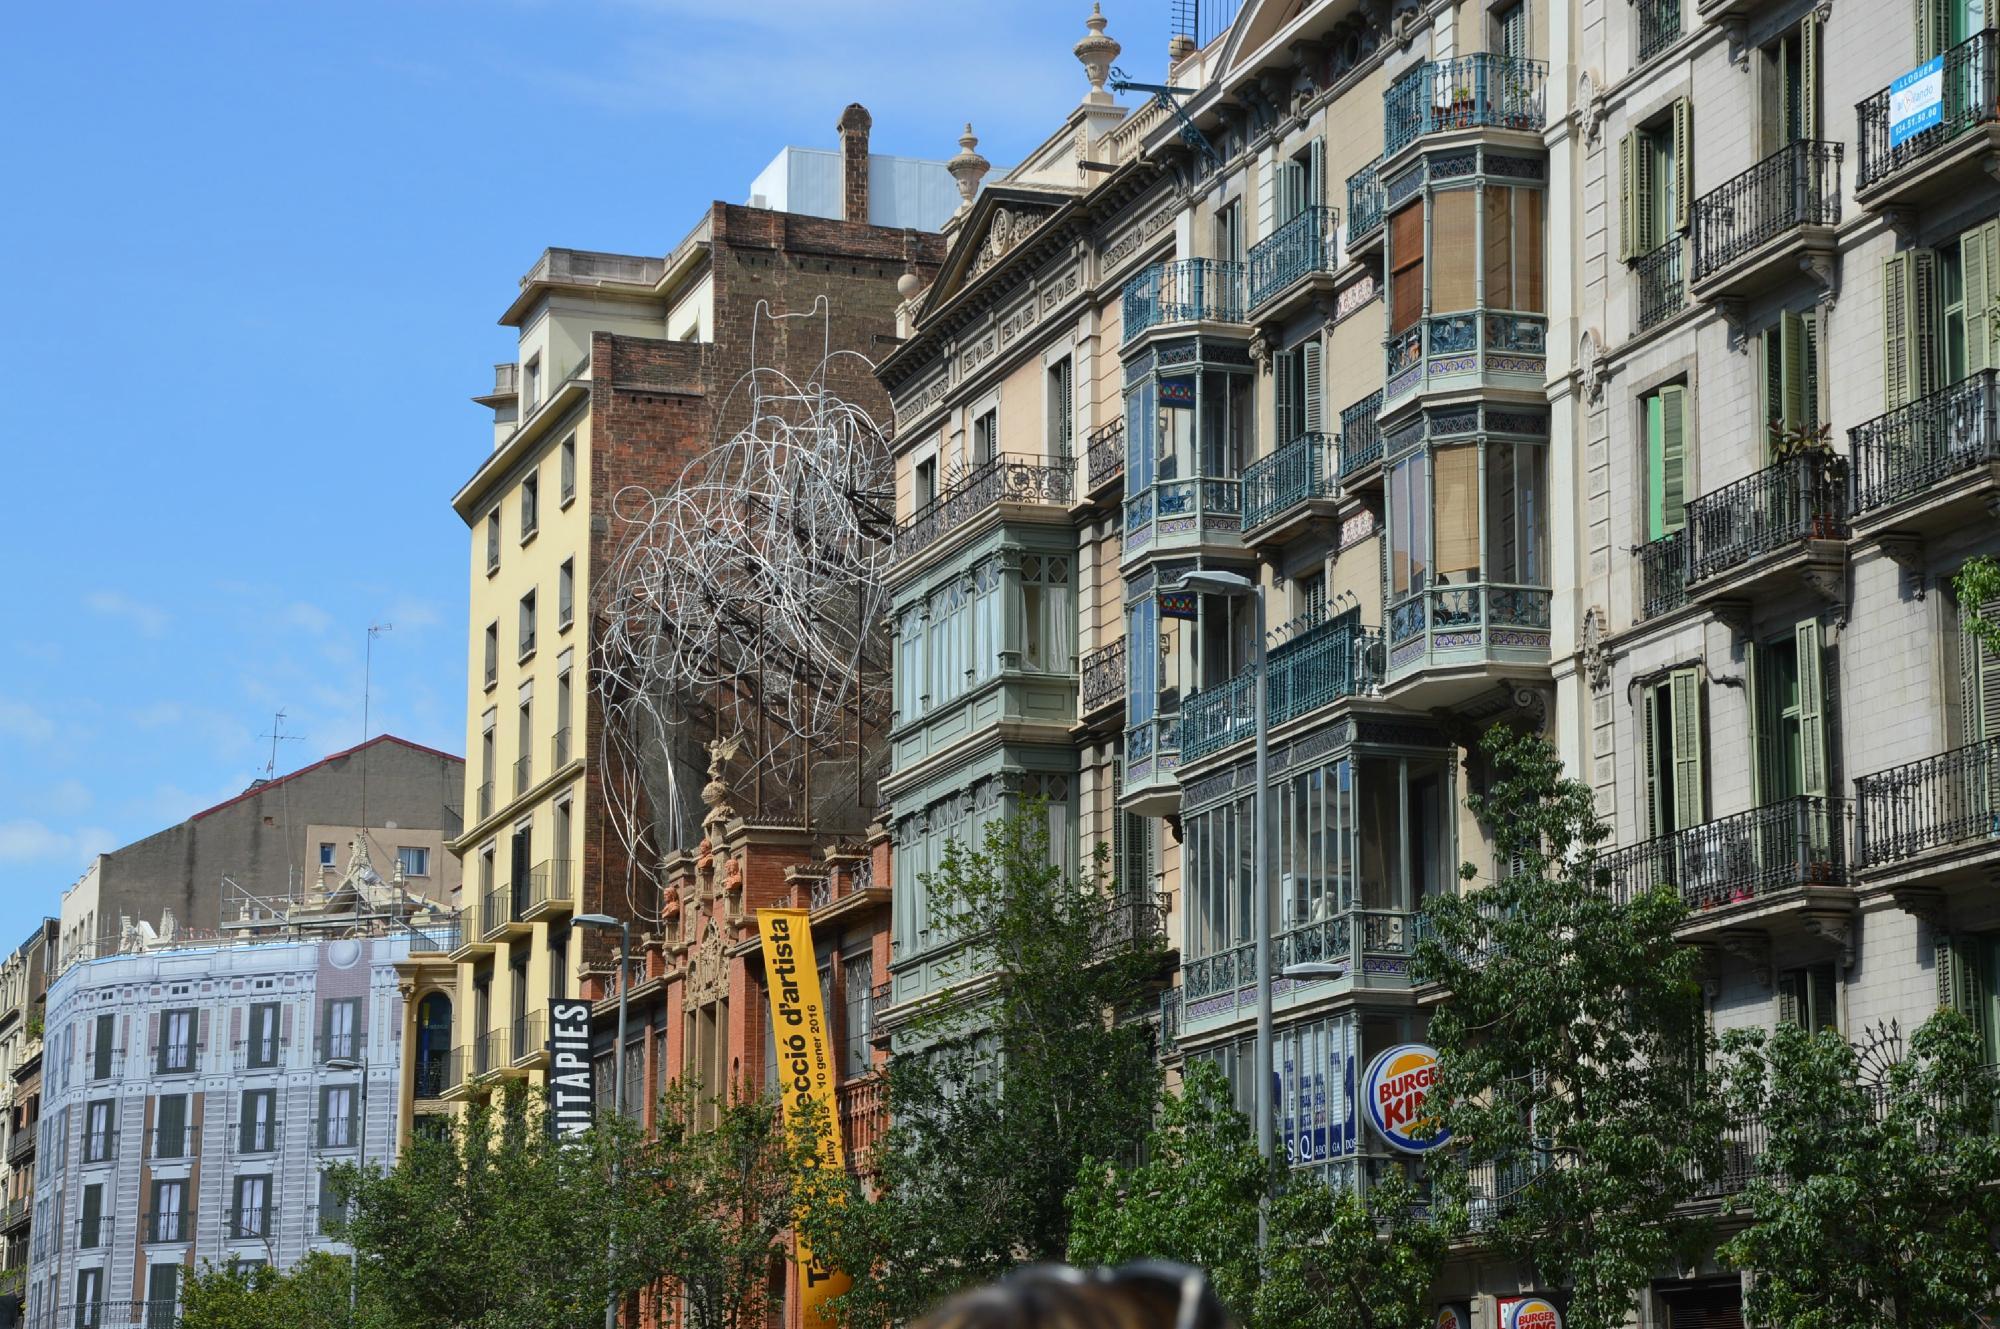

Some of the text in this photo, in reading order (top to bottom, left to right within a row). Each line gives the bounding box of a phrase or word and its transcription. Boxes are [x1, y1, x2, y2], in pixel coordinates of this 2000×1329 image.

[1899, 63, 1934, 88] LLOGUER
[769, 918, 804, 1026] d'artista
[807, 1004, 820, 1034] 2016
[813, 1036, 827, 1070] gener
[816, 1073, 826, 1089] 10
[826, 1140, 838, 1165] juny
[1518, 1311, 1555, 1325] BURGER
